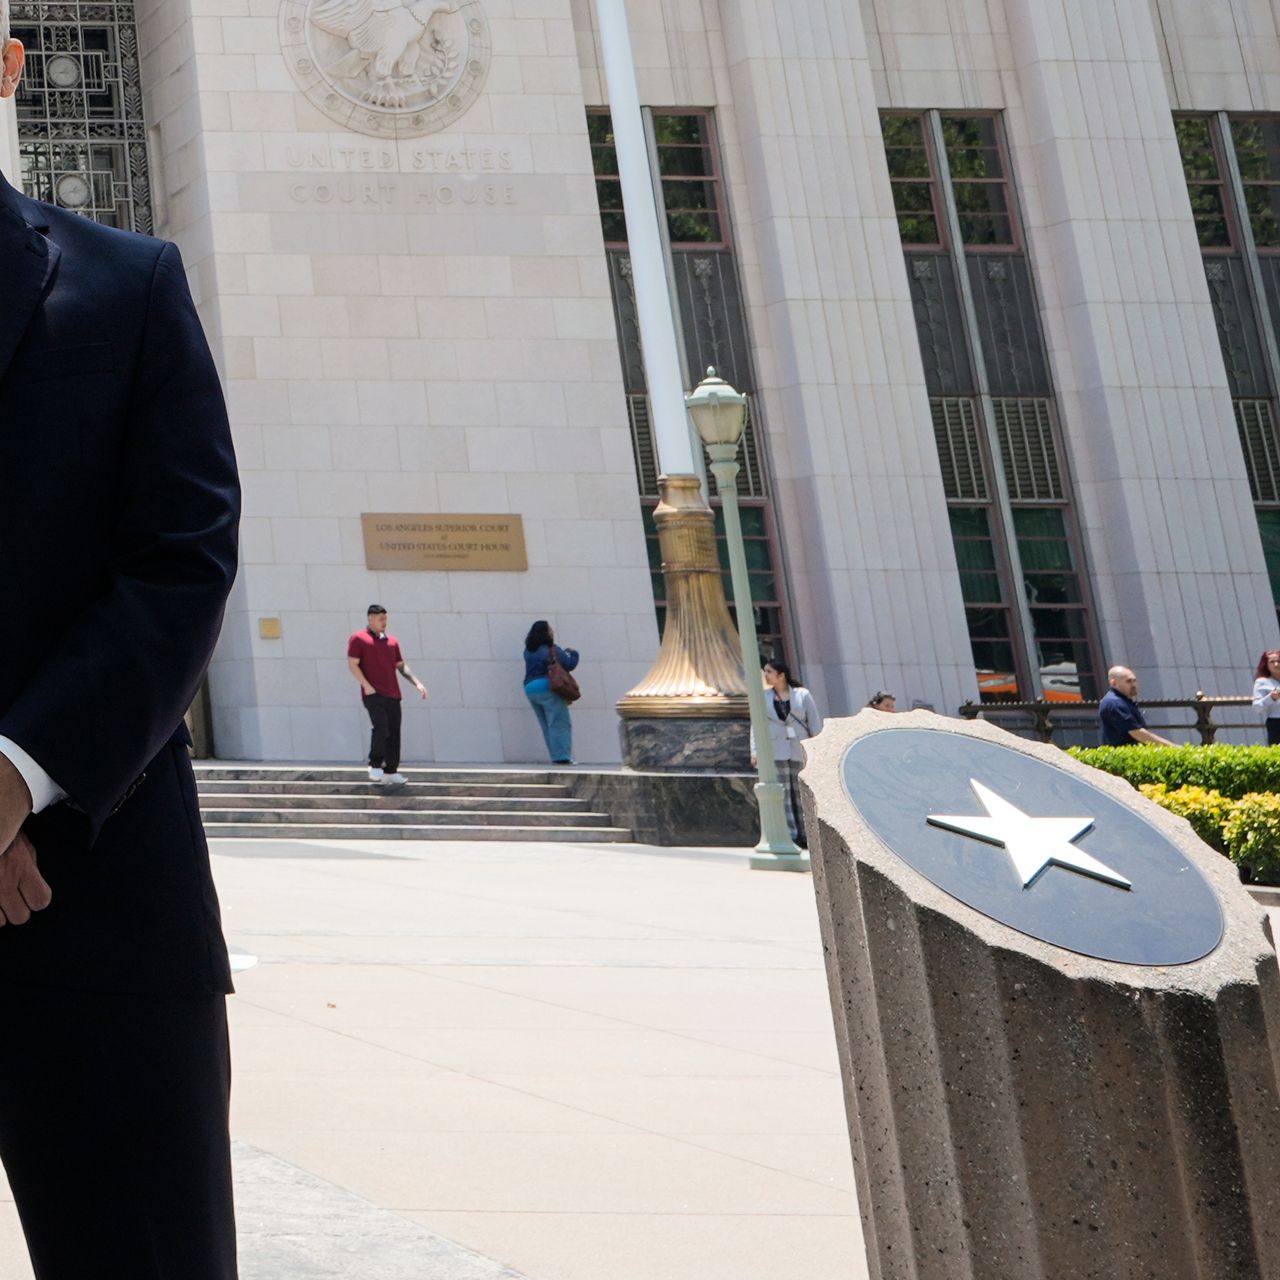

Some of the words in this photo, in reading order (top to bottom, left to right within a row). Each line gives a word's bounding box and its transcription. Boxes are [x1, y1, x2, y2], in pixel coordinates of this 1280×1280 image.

[286, 146, 393, 169] UNITED
[412, 148, 511, 170] STATES
[290, 183, 397, 204] COURT
[415, 183, 518, 205] HOUSE
[375, 523, 392, 532] LOS
[395, 523, 433, 532] ANGELES
[435, 523, 477, 532] SUPERIOR
[480, 523, 509, 532] COURT
[380, 542, 415, 552] UNITED
[416, 542, 447, 552] STATES
[448, 542, 477, 552] COURT
[480, 542, 511, 552] HOUSE
